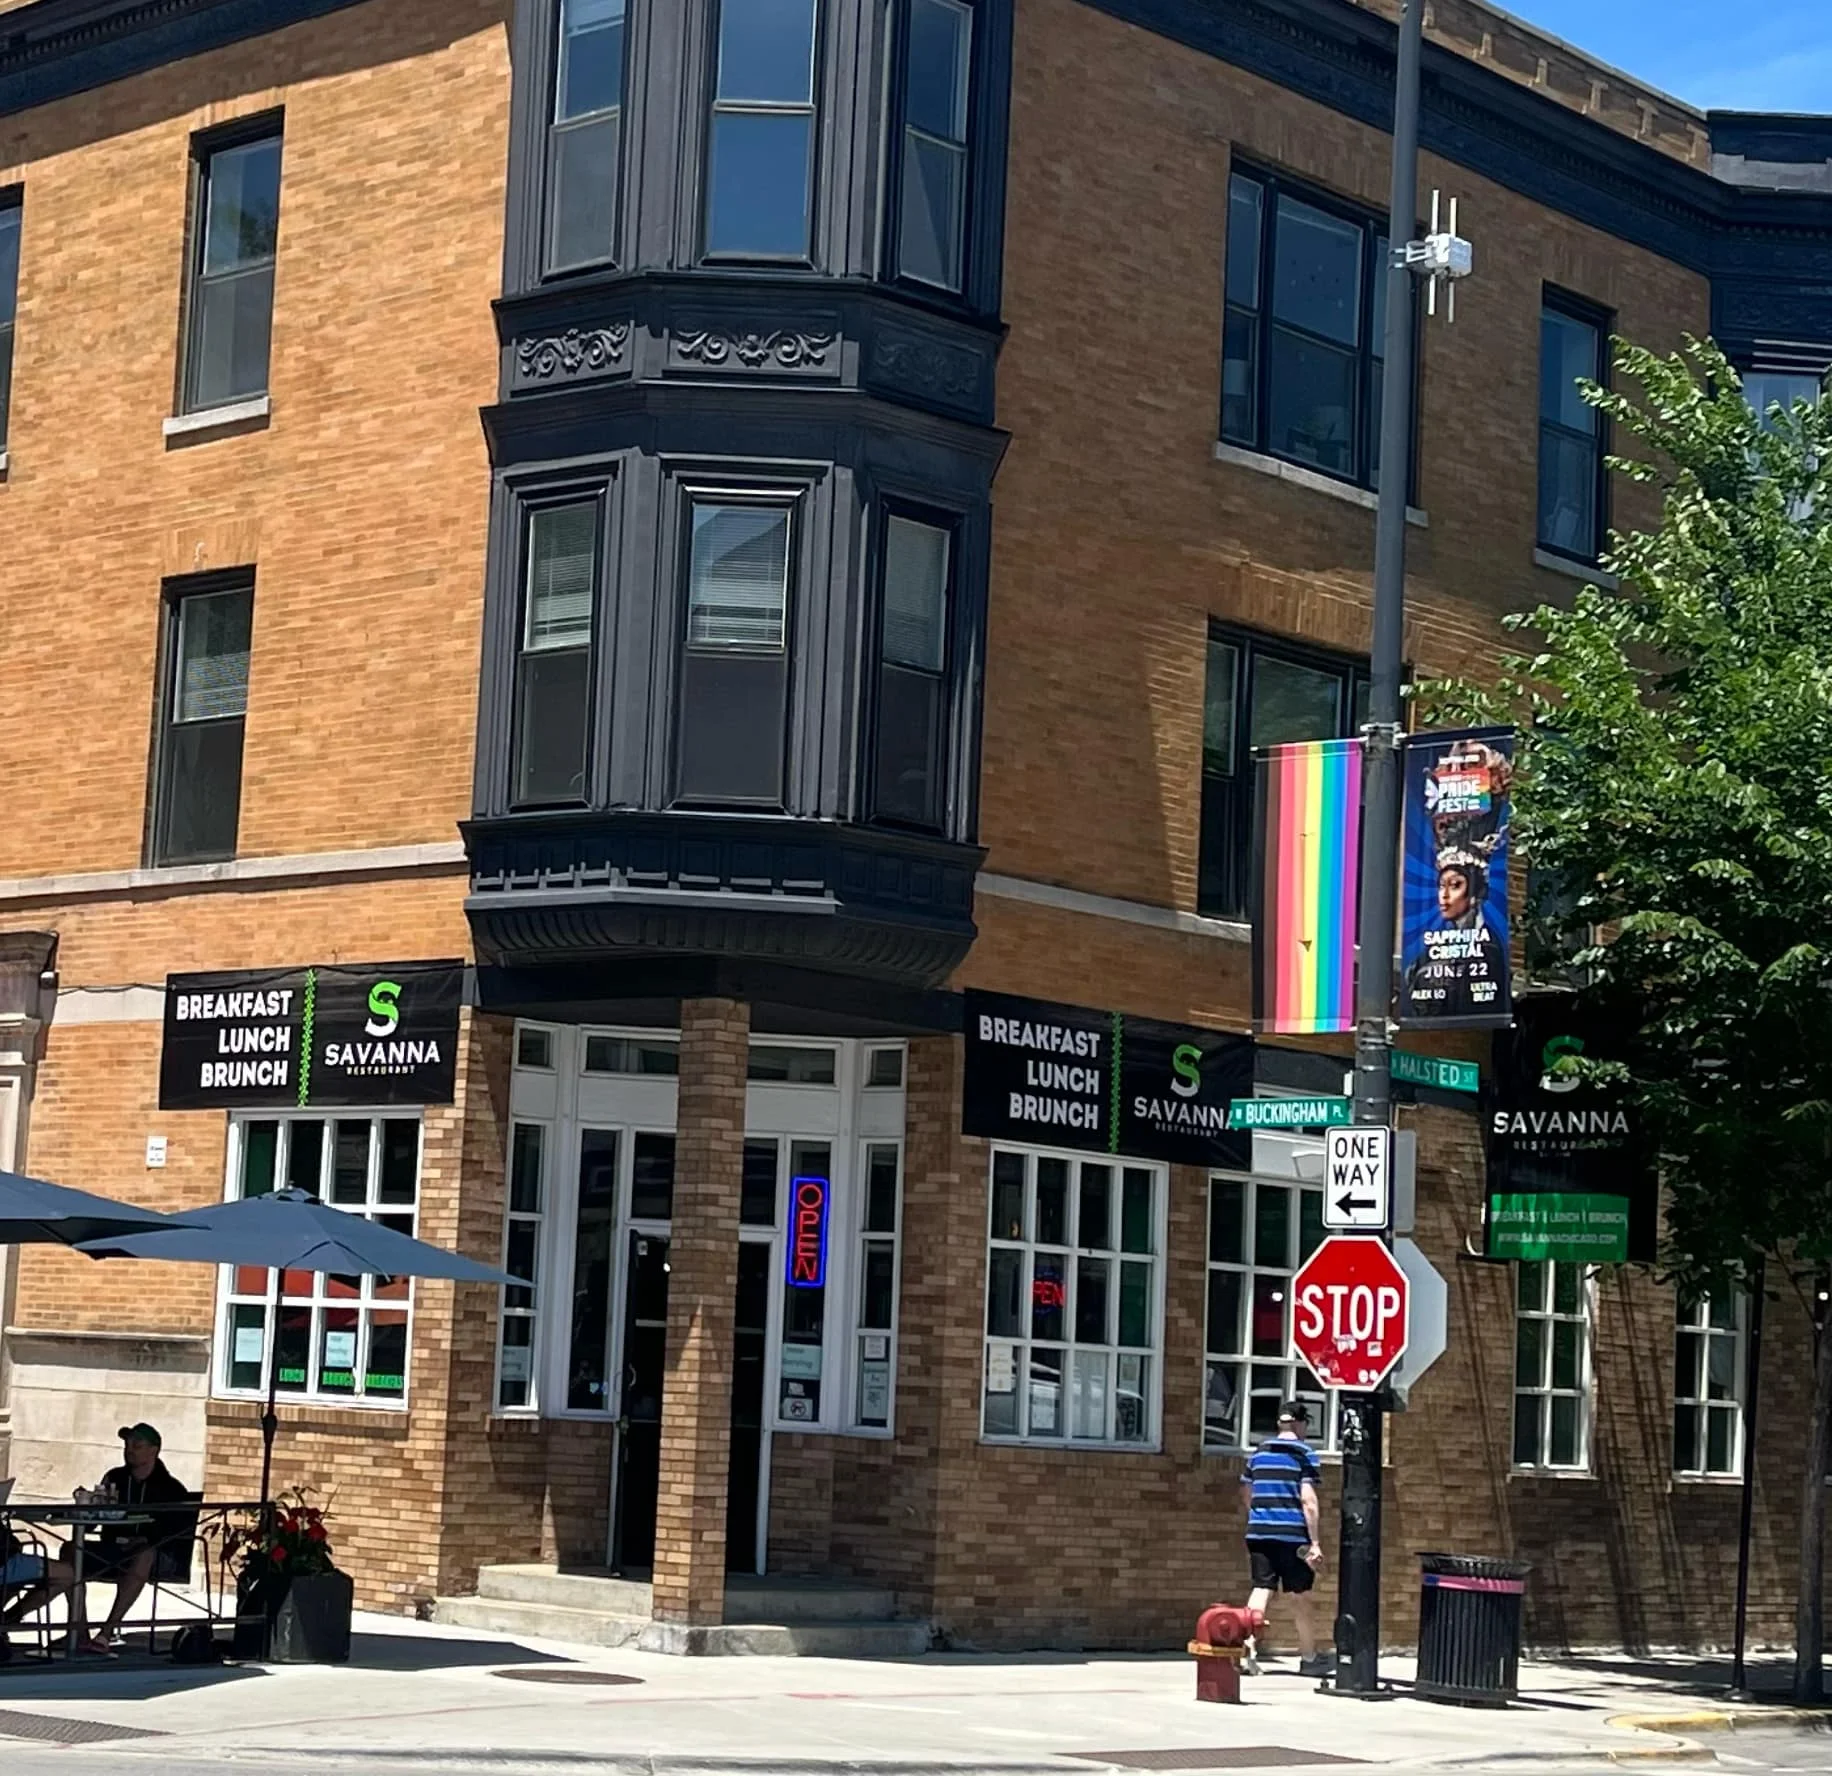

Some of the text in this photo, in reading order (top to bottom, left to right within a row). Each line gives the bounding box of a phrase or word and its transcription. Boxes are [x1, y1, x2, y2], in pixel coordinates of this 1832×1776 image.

[1424, 928, 1490, 945] SAPPHIRA
[1429, 943, 1484, 960] CRISTAL
[1424, 962, 1488, 978] JUNE 22
[176, 990, 293, 1020] BREAKFAST
[218, 1026, 291, 1054] LUNCH
[979, 1014, 1101, 1058] BREAKFAST
[324, 1040, 441, 1066] SAVANNA
[200, 1060, 288, 1088] BRUNCH
[1027, 1059, 1100, 1095] LUNCH
[1400, 1055, 1460, 1086] HALSTED
[1463, 1071, 1474, 1083] ST
[1009, 1092, 1099, 1130] BRUNCH
[1245, 1101, 1328, 1125] BUCKINGHAM
[1332, 1105, 1344, 1118] PL
[1493, 1111, 1630, 1134] SAVANNA
[1334, 1136, 1380, 1159] ONE
[1332, 1163, 1380, 1187] WAY
[795, 1183, 823, 1281] OPEN
[1300, 1284, 1401, 1341] STOP
